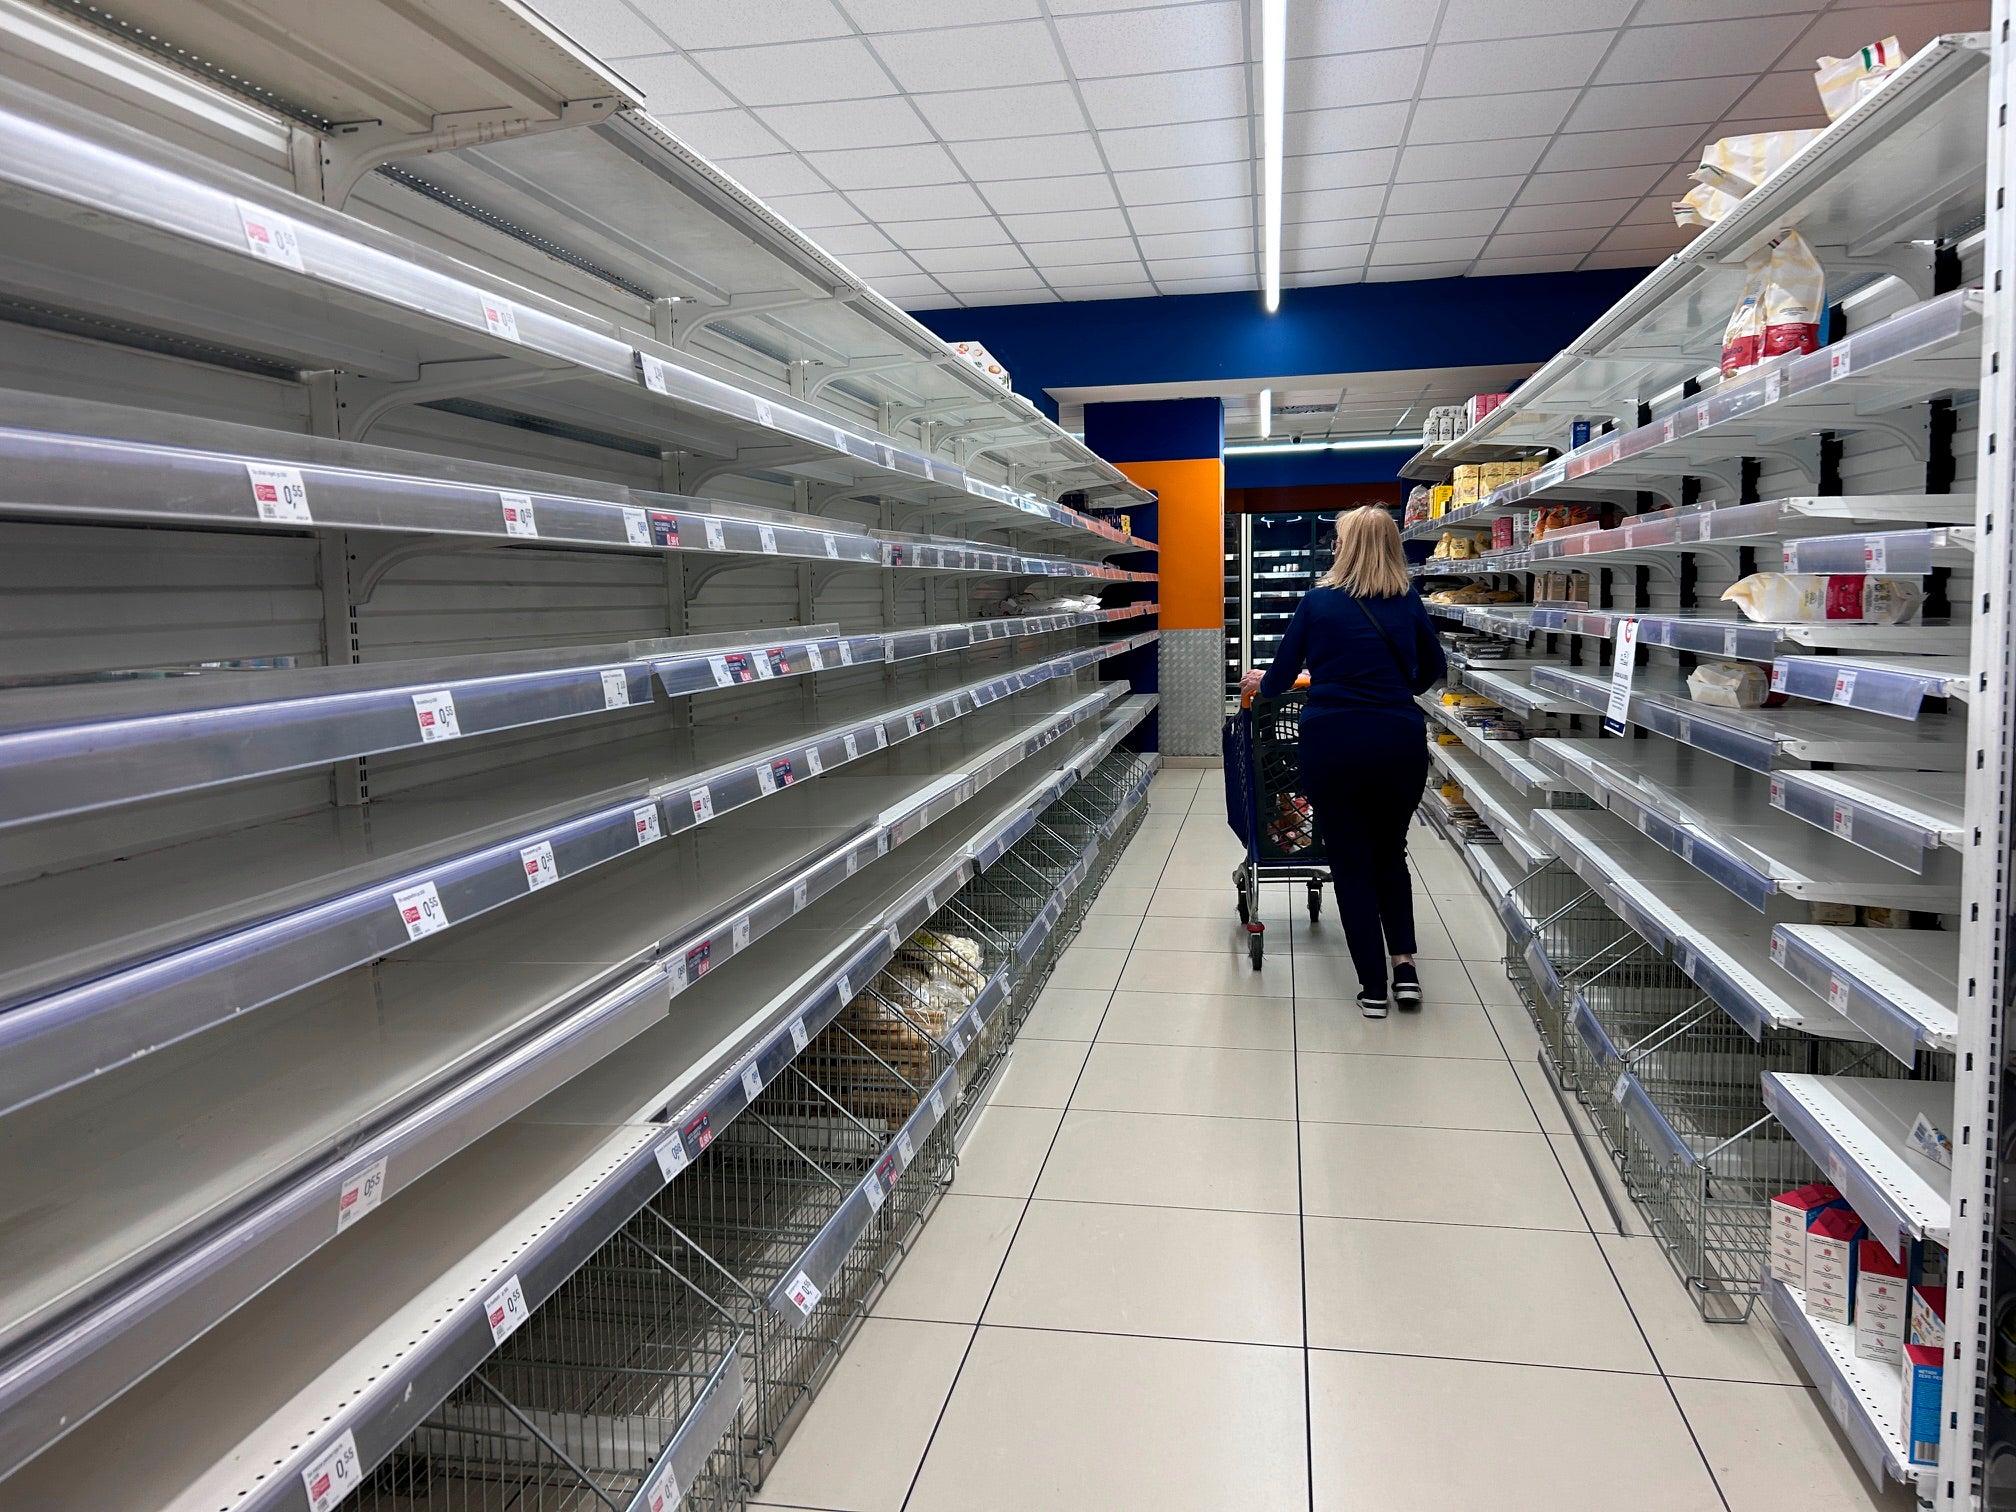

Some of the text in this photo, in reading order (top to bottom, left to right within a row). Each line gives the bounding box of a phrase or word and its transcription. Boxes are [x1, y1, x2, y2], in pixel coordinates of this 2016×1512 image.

[283, 485, 304, 510] 0,55
[520, 508, 532, 528] 0,55
[439, 705, 454, 728] 0,55
[541, 852, 553, 872] 0,55
[423, 896, 439, 920] 0,55
[364, 1171, 381, 1197] 0,55
[507, 1288, 521, 1313] 0,55
[335, 1446, 354, 1479] 0,55
[664, 1473, 675, 1499] 0,55
